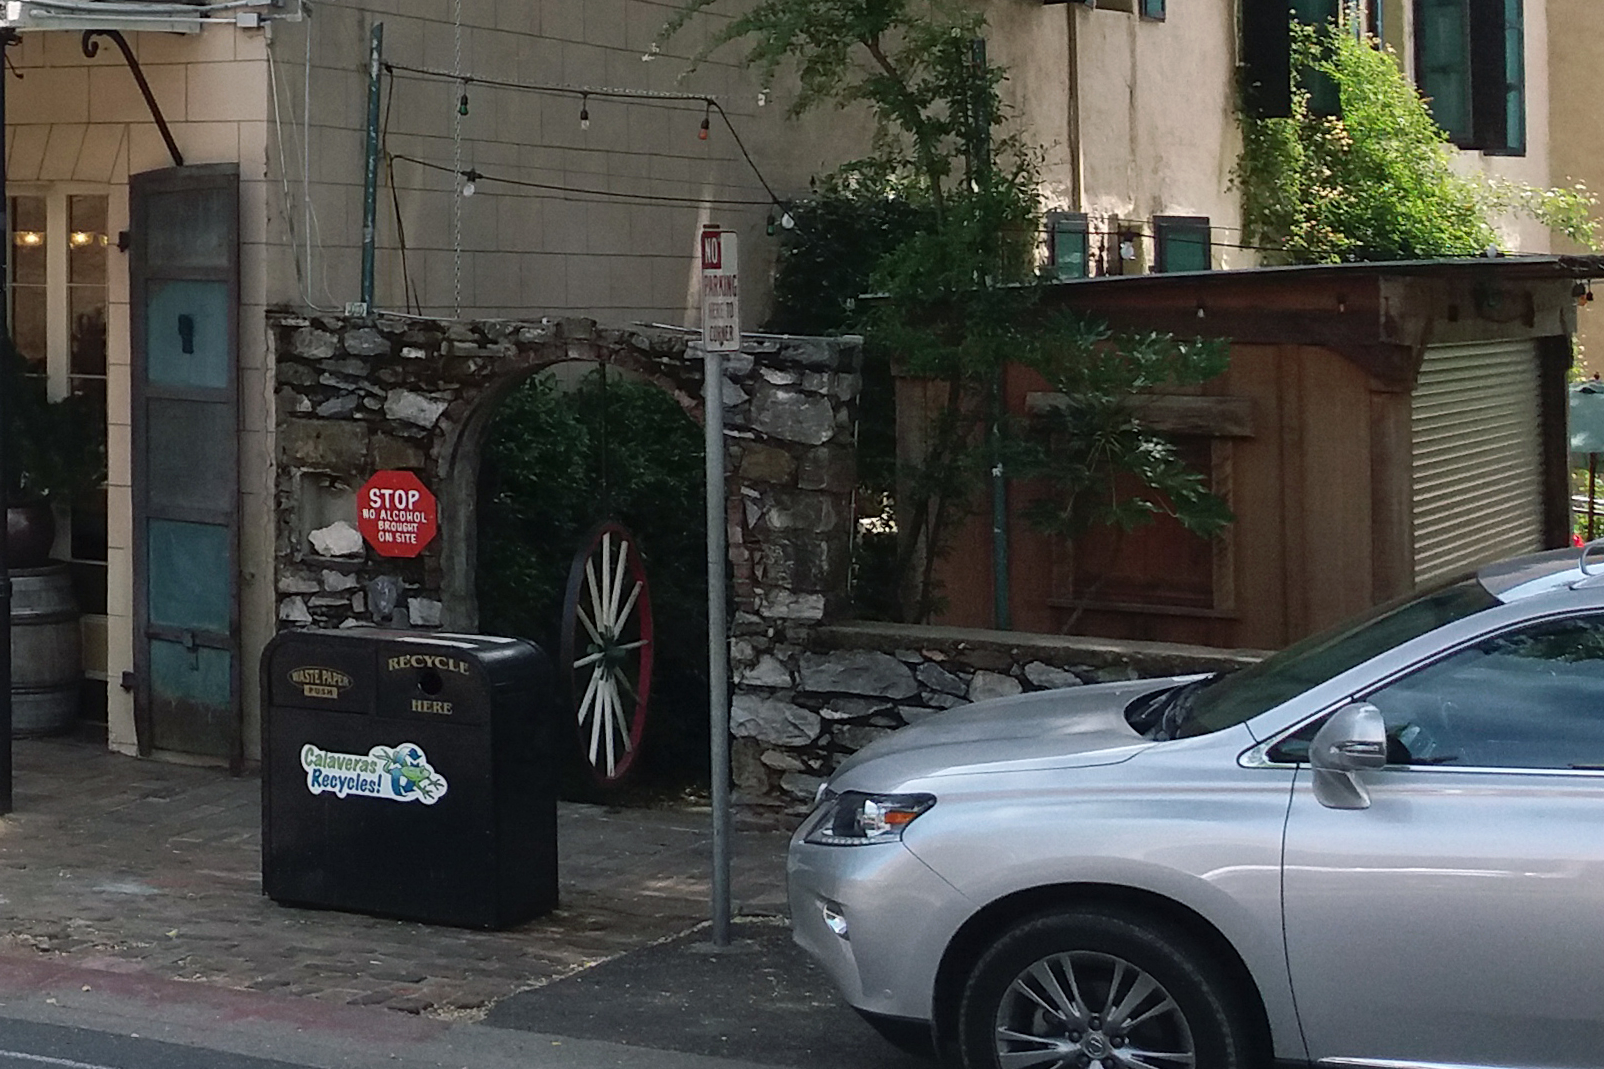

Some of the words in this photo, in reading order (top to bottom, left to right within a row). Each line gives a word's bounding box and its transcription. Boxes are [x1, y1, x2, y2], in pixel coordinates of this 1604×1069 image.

[704, 237, 718, 264] NO
[704, 274, 737, 297] PARKING
[369, 488, 420, 509] STOP
[362, 508, 376, 519] NO
[380, 509, 428, 523] ALCOHOL
[377, 520, 419, 533] BROUGHT
[378, 531, 393, 542] ON
[395, 533, 417, 544] SITE
[387, 653, 470, 675] RECYCLE
[291, 668, 321, 684] WASTE
[322, 670, 351, 687] PAPER
[307, 686, 335, 697] PUSH
[411, 698, 453, 715] HERE
[304, 746, 378, 774] Calaveras
[311, 768, 382, 795] Recycles!
